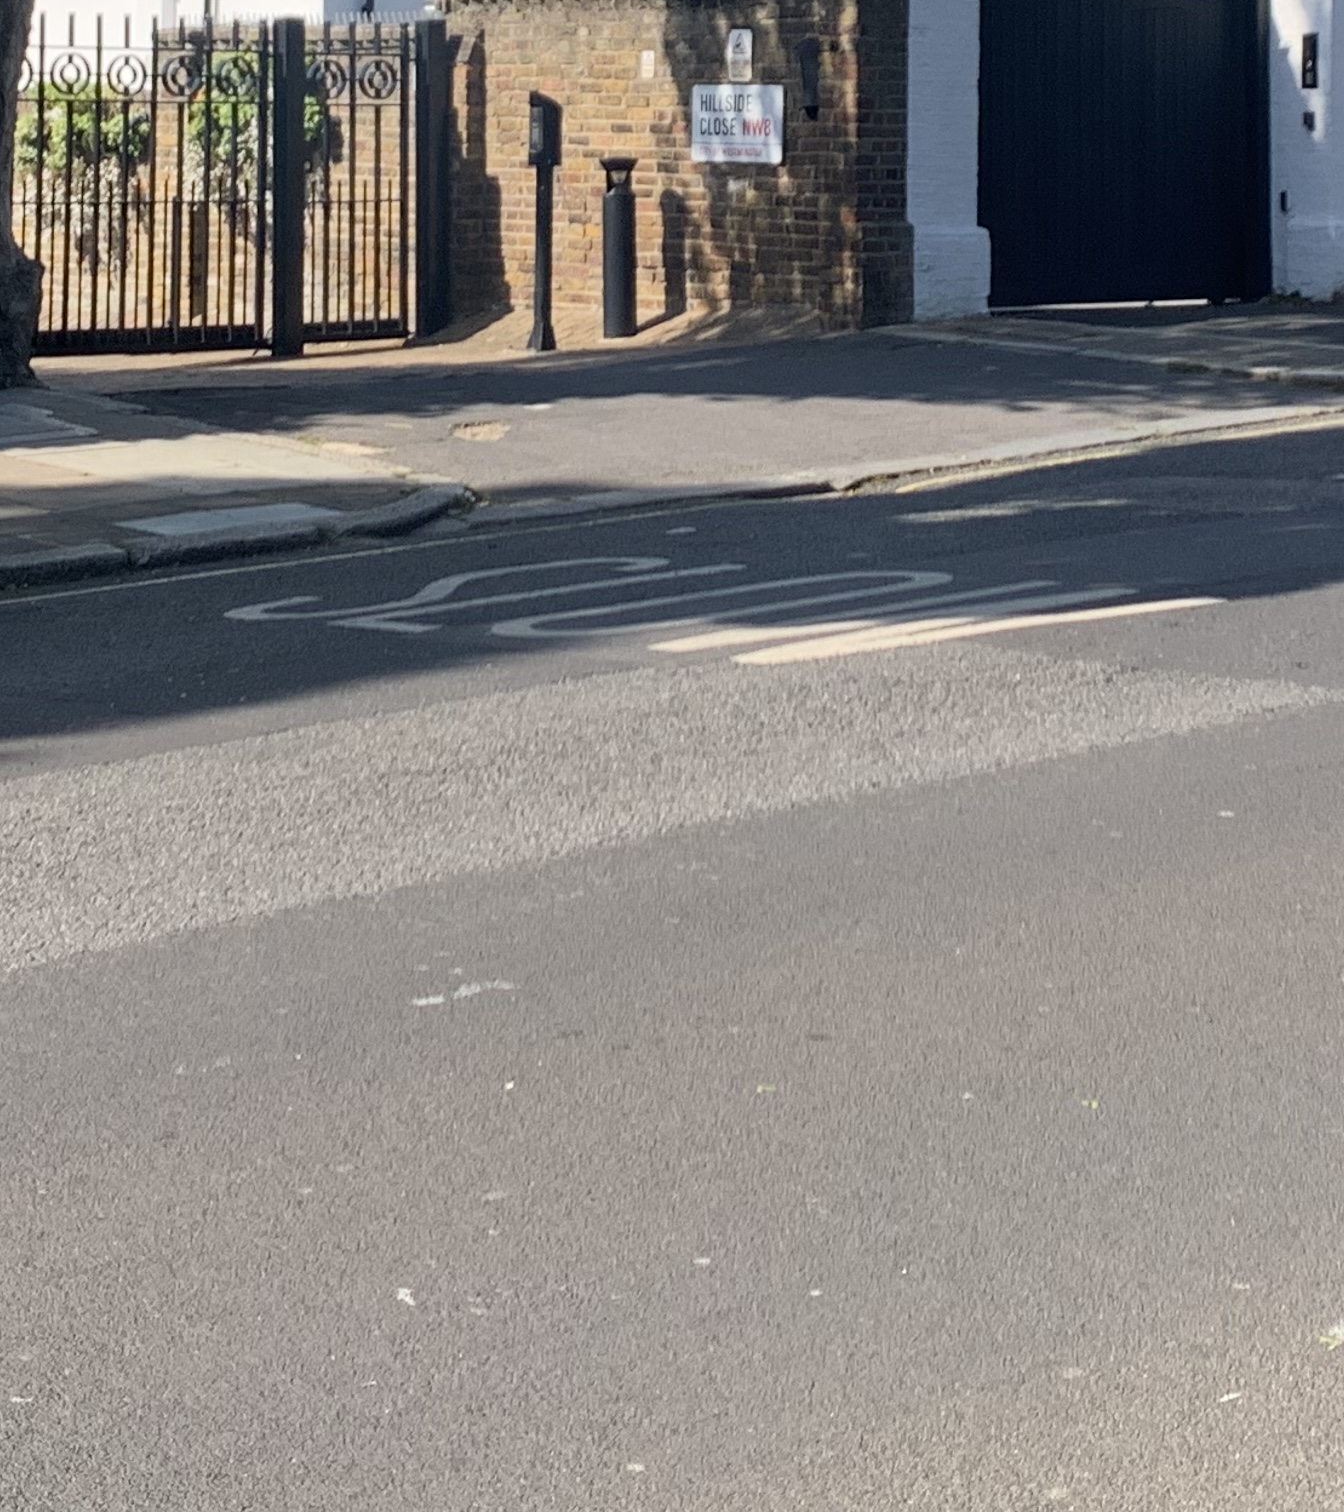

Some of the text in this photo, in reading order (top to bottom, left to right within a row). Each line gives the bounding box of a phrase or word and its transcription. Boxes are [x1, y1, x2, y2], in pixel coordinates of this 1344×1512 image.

[700, 93, 752, 113] HILLSIDE
[700, 116, 772, 137] CLOSE NW8
[224, 556, 1229, 666] SLOW
